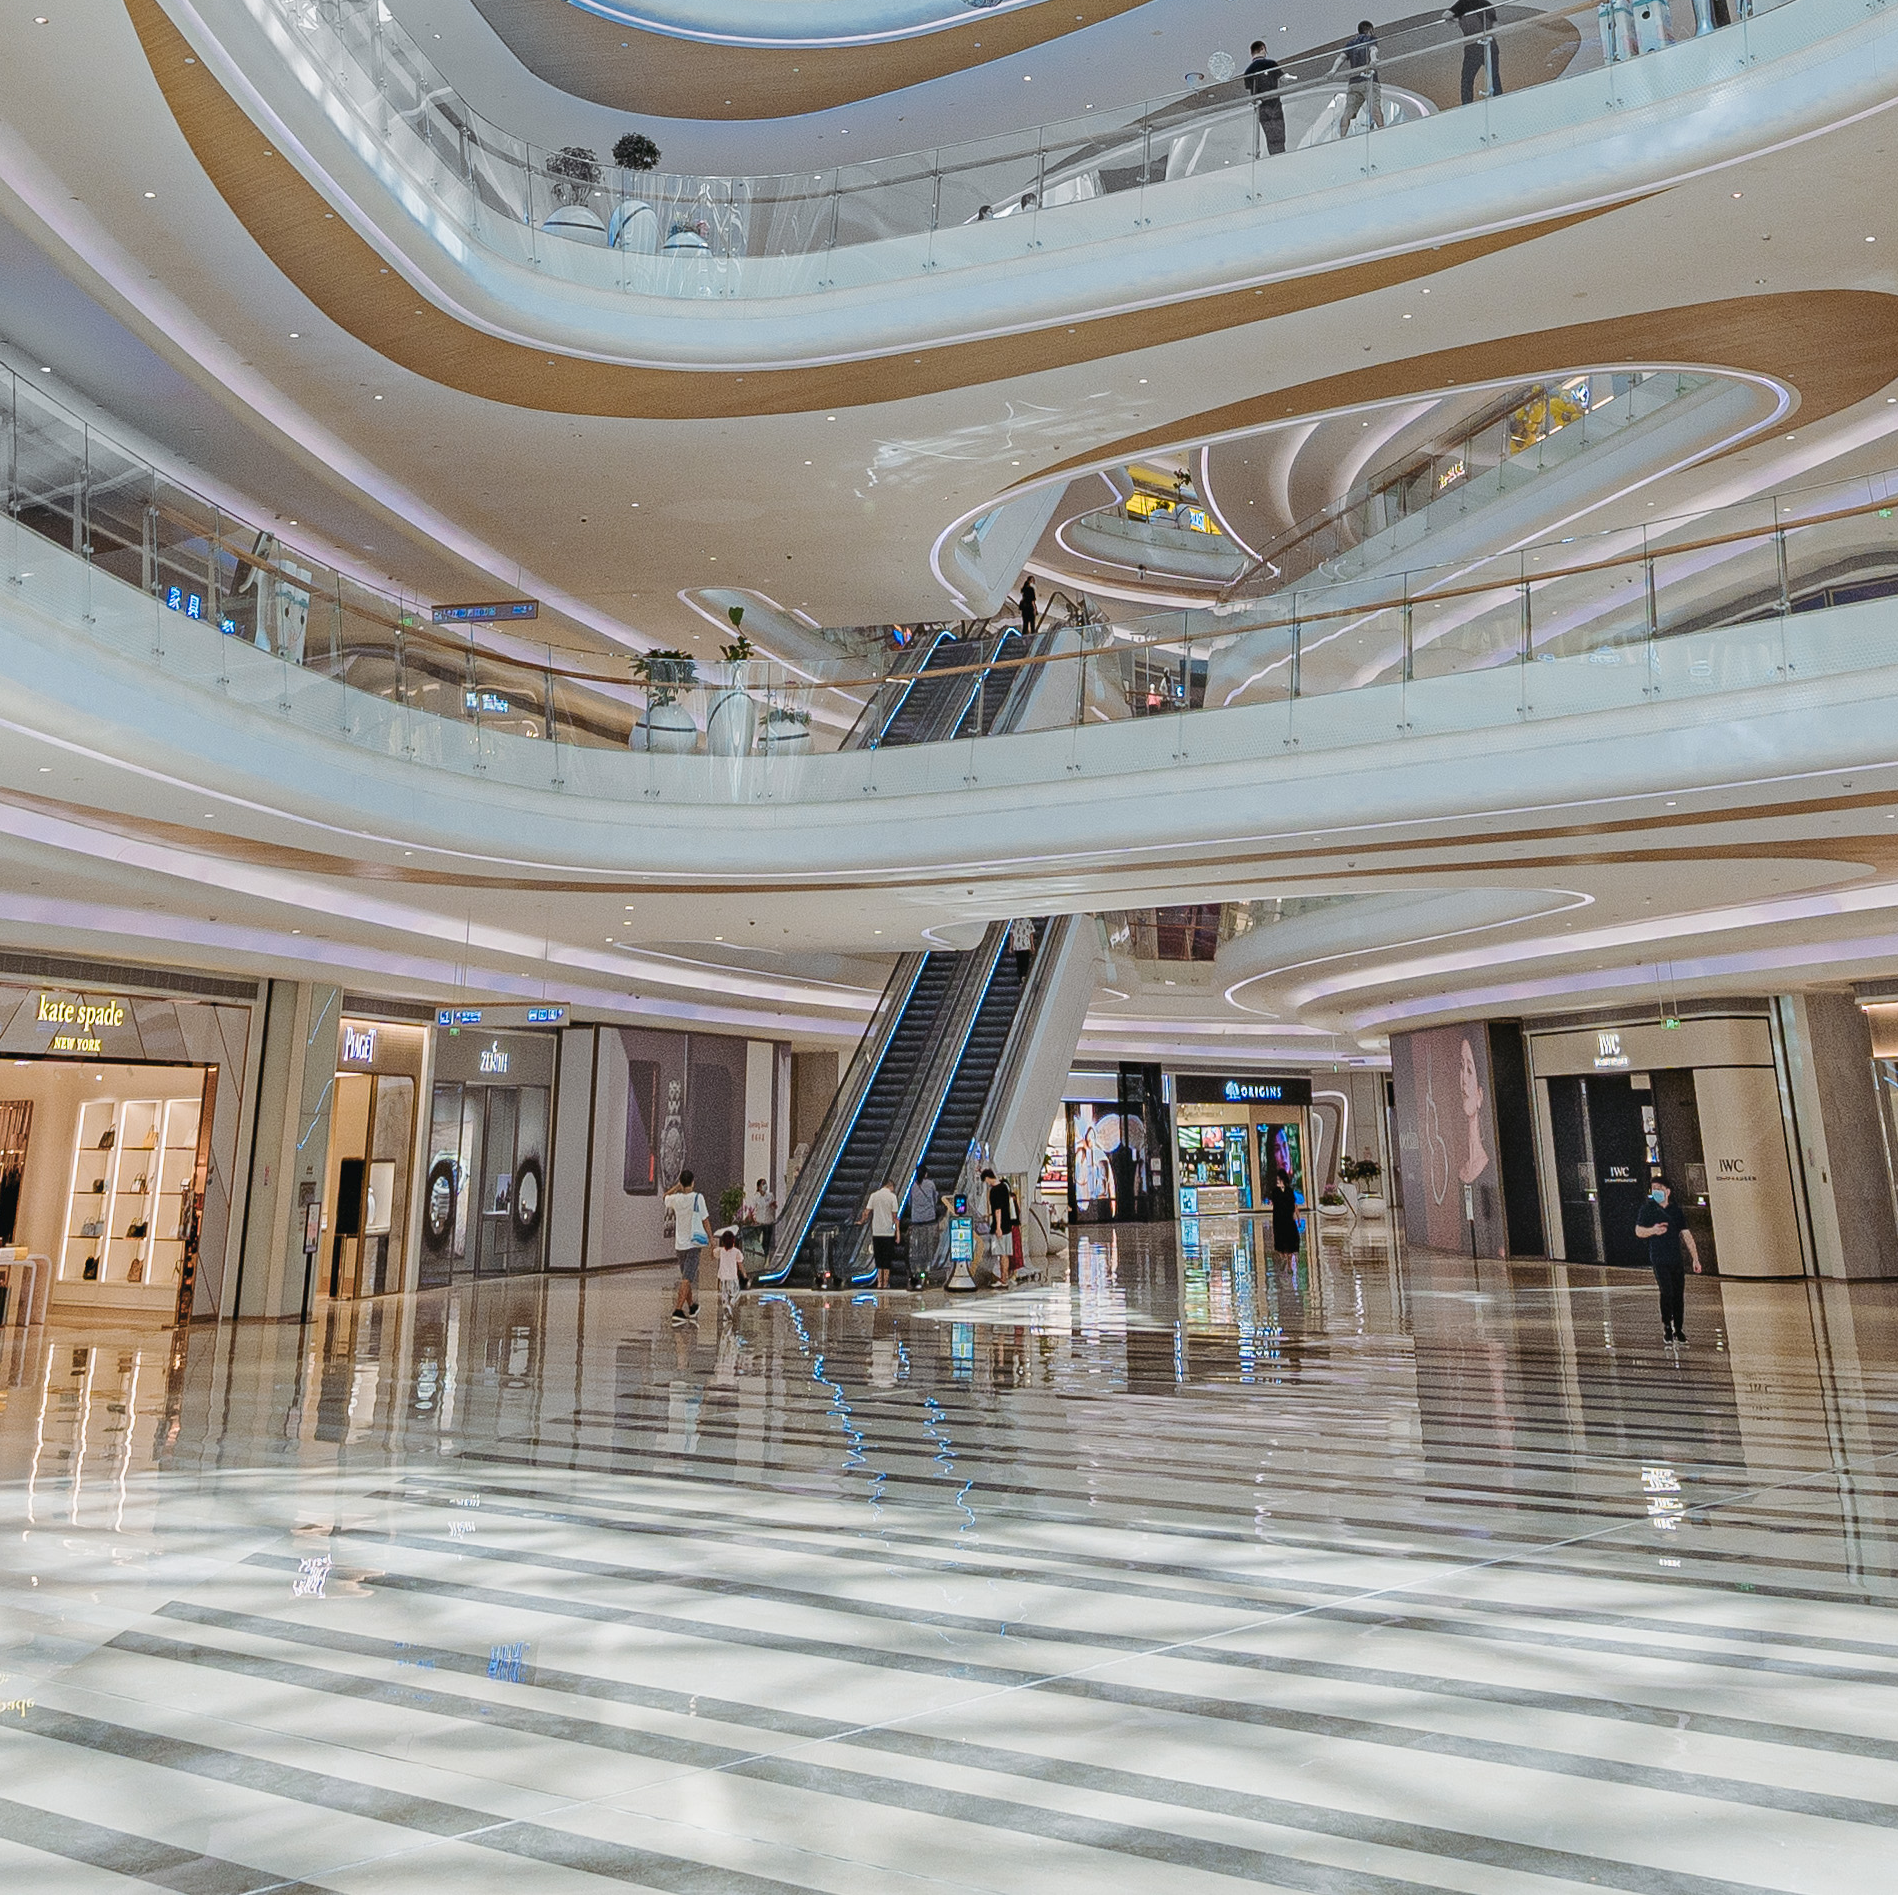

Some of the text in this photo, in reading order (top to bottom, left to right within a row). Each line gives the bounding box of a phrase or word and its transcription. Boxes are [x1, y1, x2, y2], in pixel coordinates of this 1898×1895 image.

[37, 994, 124, 1032] kate spade
[53, 1036, 101, 1052] NEW YORK
[343, 1026, 377, 1063] PIAGET
[1597, 1033, 1620, 1056] IWC
[1240, 1085, 1282, 1099] ORIGINS
[1609, 1166, 1630, 1178] IWC
[1719, 1159, 1745, 1173] IWC
